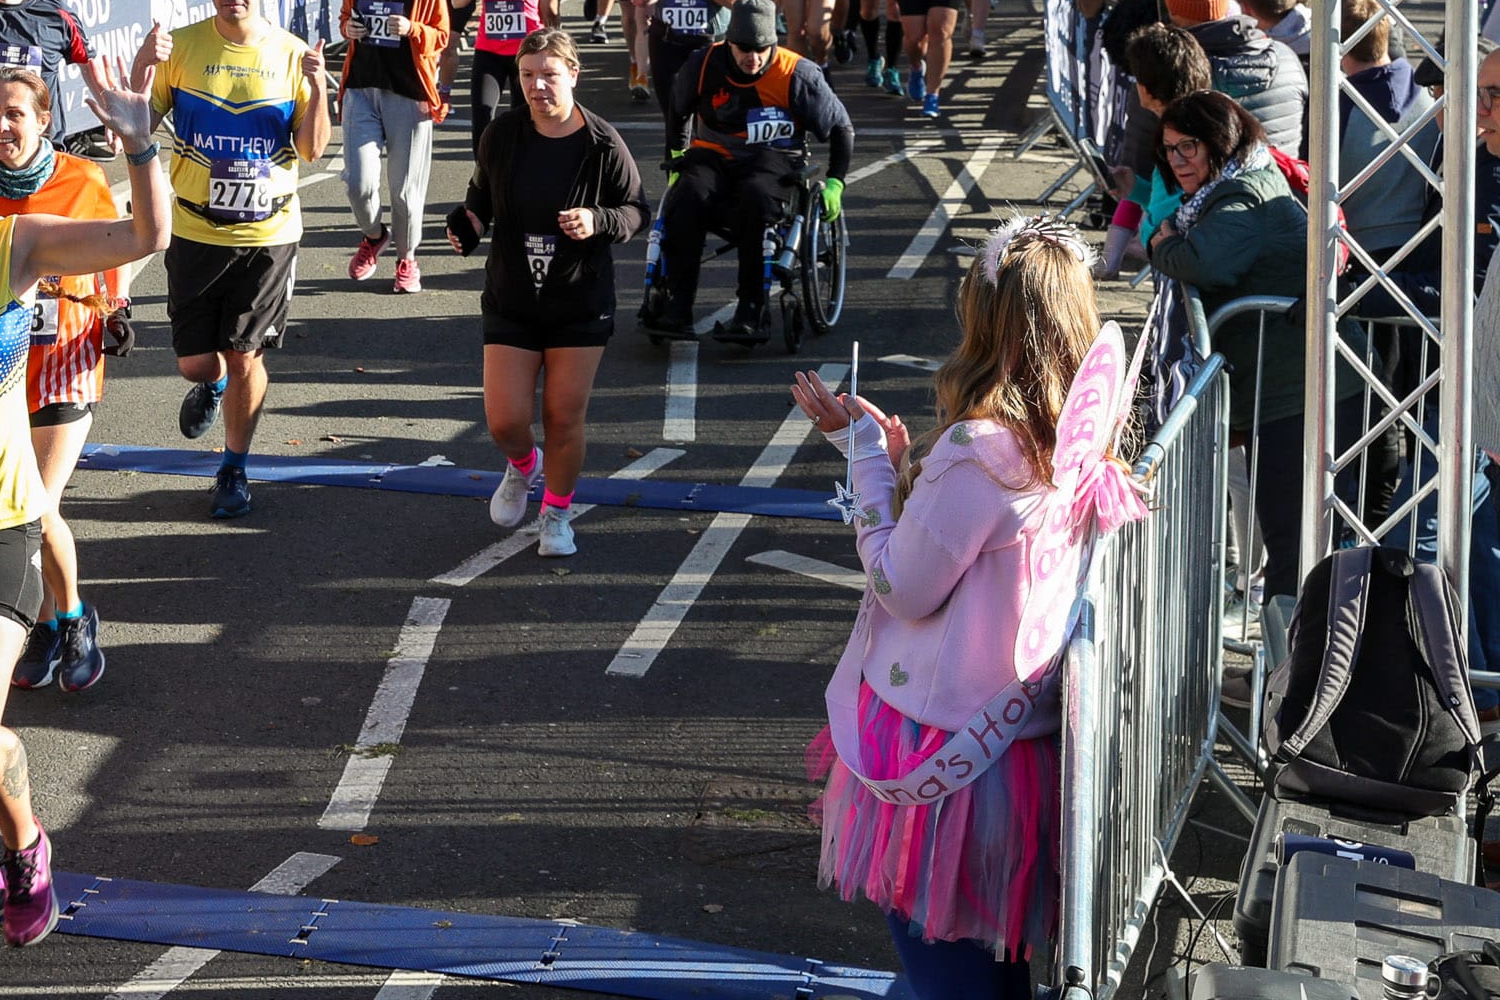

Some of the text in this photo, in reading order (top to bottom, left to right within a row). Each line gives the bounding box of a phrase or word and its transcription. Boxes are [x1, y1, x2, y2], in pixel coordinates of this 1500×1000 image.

[487, 14, 522, 31] 3091
[665, 9, 706, 25] 3104
[193, 133, 276, 154] MATTHEW
[213, 181, 268, 208] 2778
